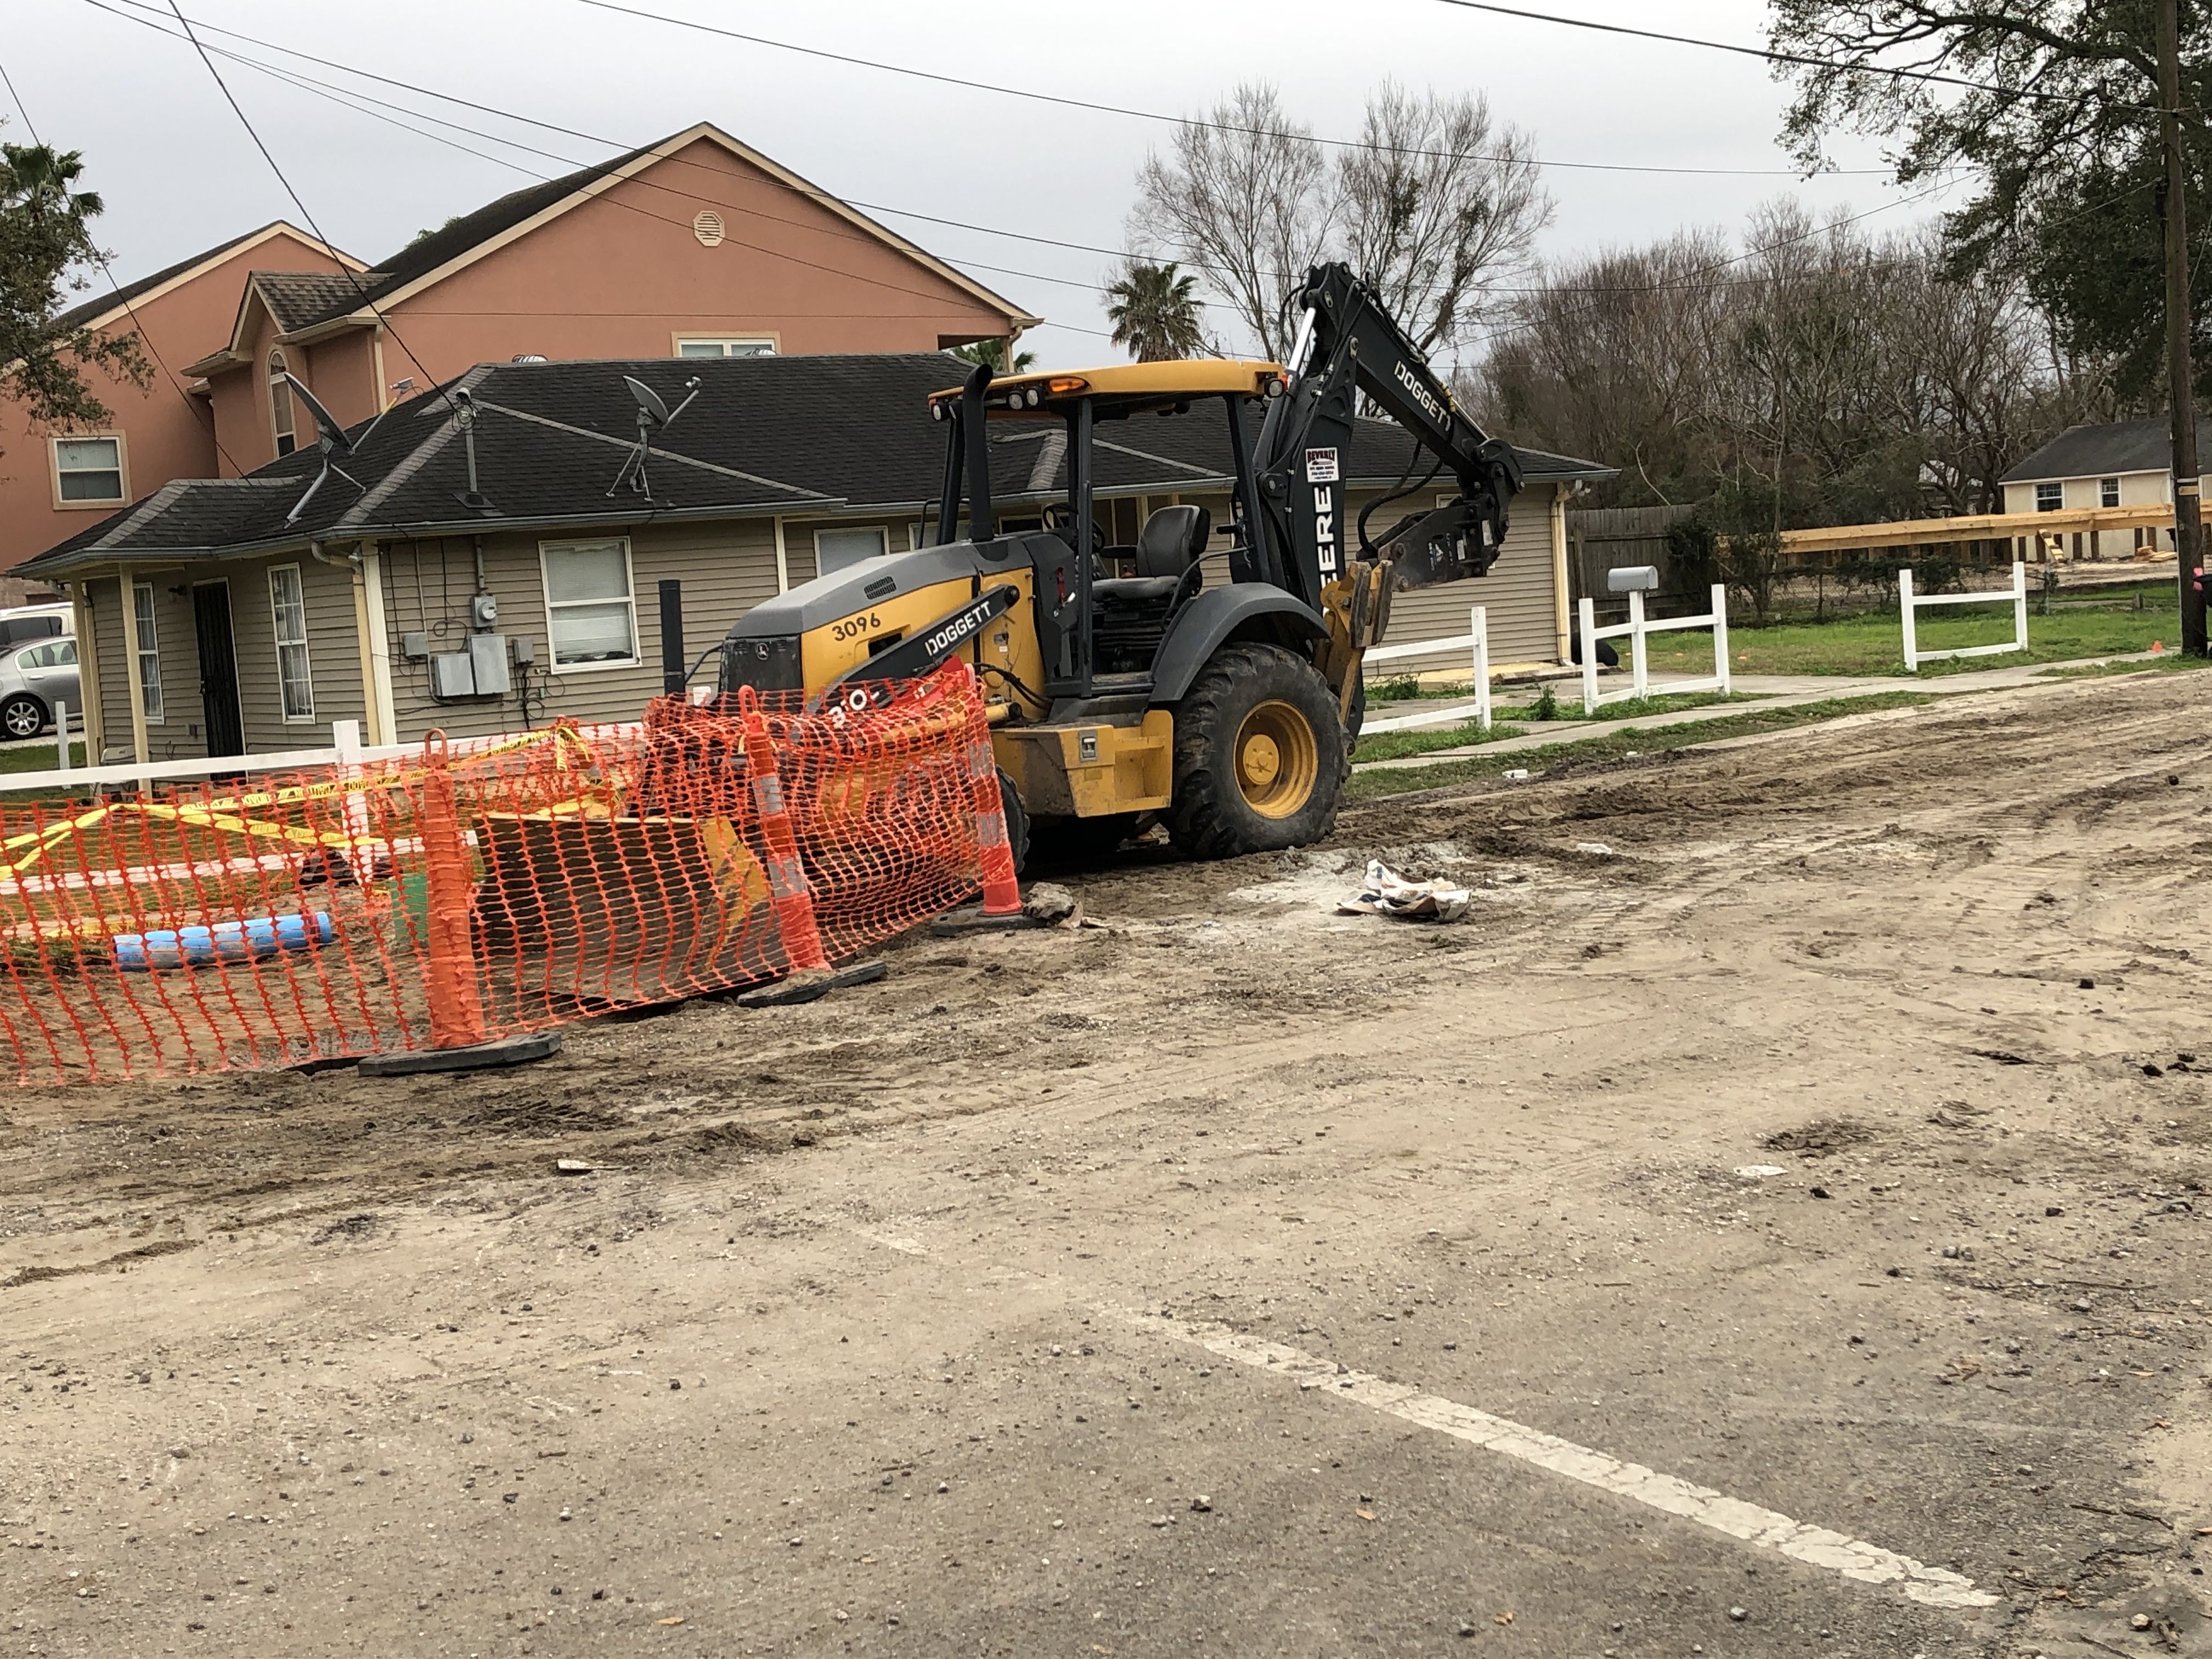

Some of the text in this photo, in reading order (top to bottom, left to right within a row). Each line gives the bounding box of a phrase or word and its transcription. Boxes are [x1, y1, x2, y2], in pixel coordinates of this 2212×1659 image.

[1394, 360, 1451, 431] DOGGETT
[1307, 449, 1335, 464] BEVERLY
[832, 612, 881, 641] 3096
[924, 601, 991, 657] DOGGETT
